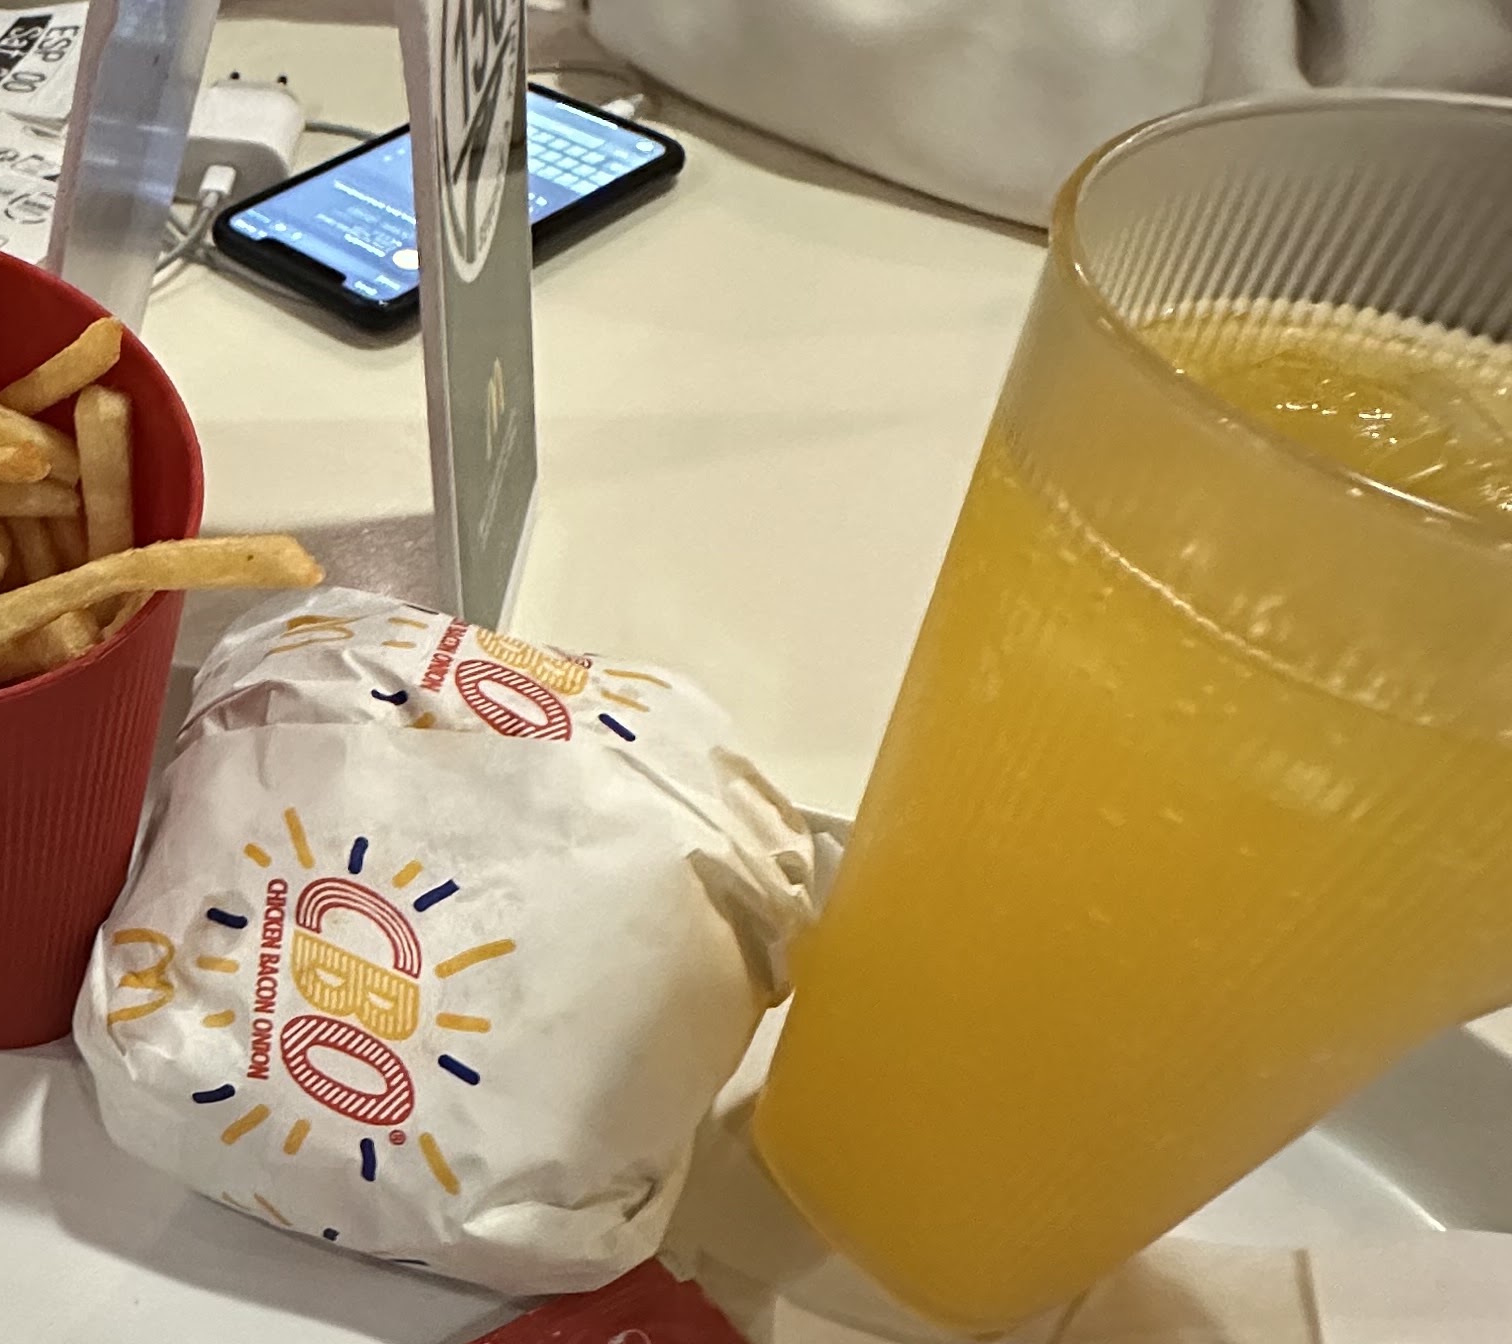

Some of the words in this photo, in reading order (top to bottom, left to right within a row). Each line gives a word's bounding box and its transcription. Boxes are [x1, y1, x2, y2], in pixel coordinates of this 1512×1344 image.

[455, 624, 591, 741] BO
[261, 879, 288, 952] CHICKEN
[254, 955, 281, 1017] BACON
[280, 876, 422, 1126] CBO
[246, 1020, 273, 1080] ONION
